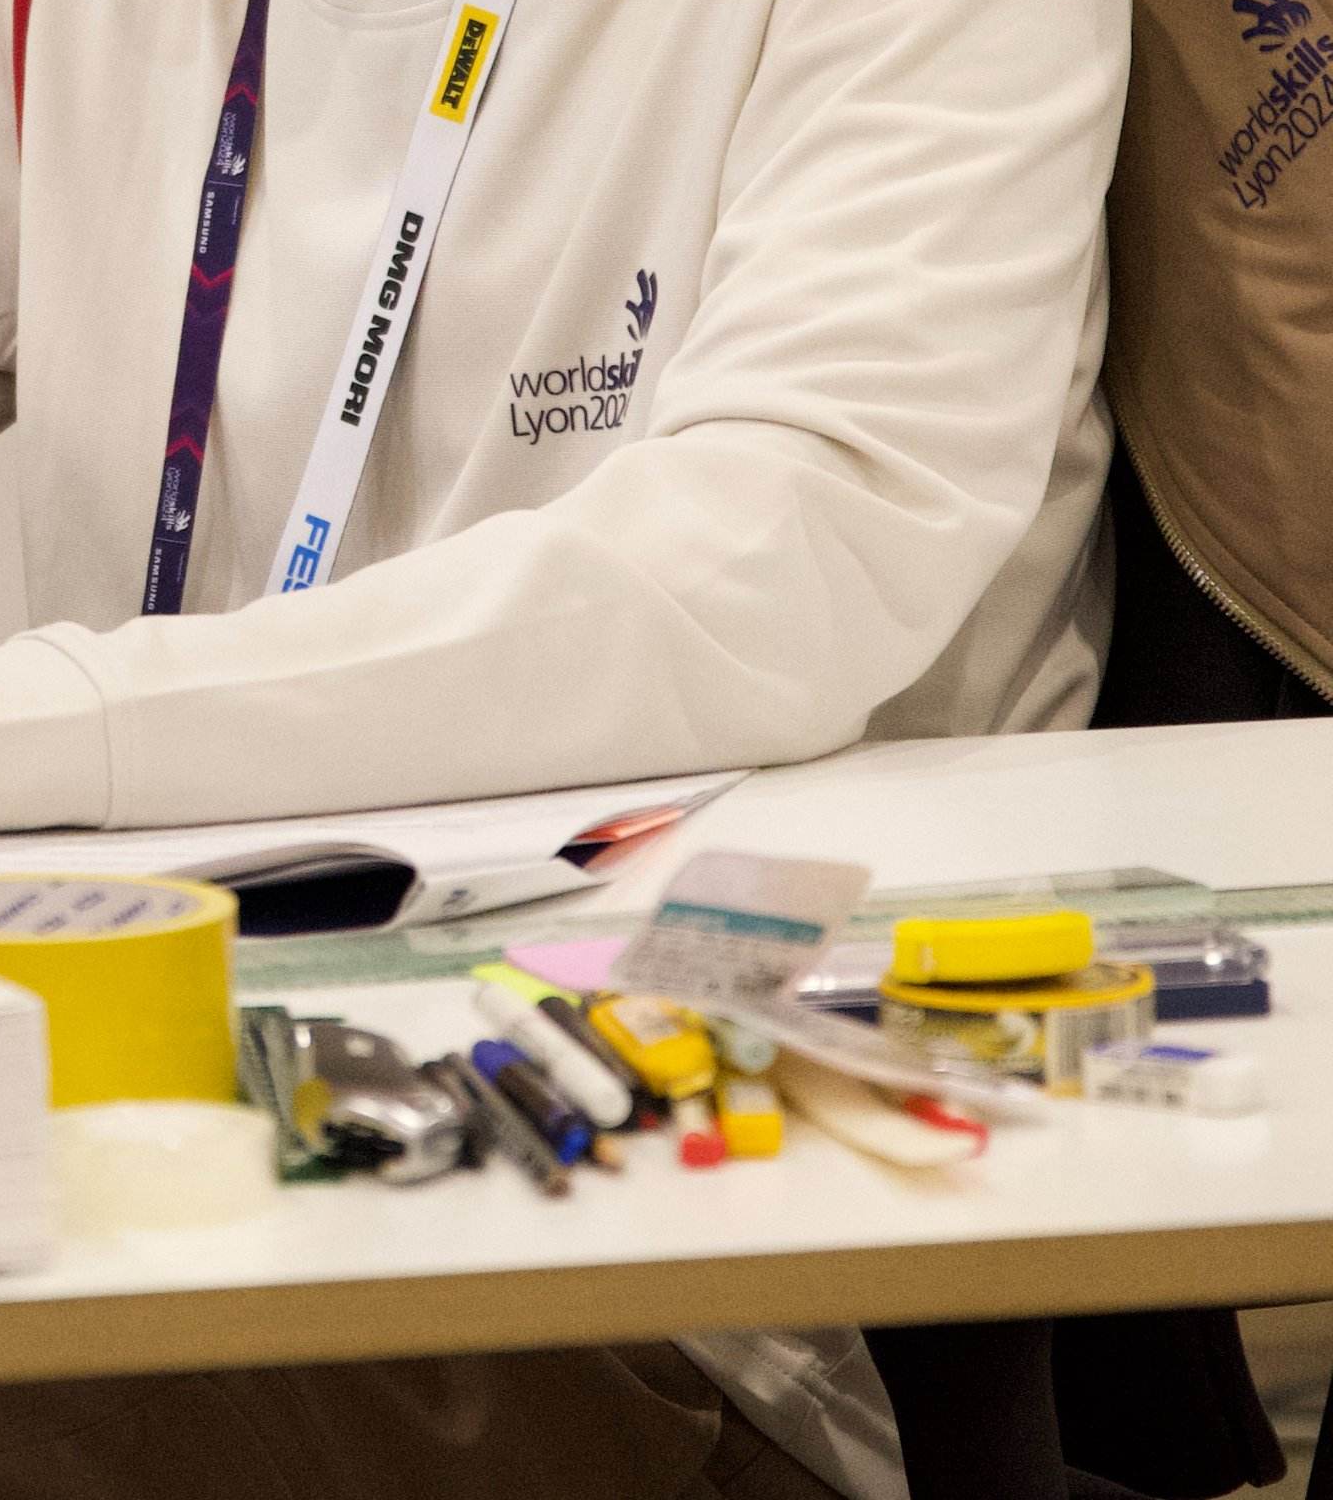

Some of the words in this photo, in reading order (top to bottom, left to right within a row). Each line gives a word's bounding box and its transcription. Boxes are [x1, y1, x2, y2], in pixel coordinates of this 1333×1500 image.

[1218, 34, 1333, 178] worldskills
[199, 191, 216, 255] SAMSUNG
[378, 210, 425, 311] DMG
[340, 314, 392, 427] MORI
[510, 389, 633, 446] Lyon202
[148, 548, 163, 611] SAMSUNG
